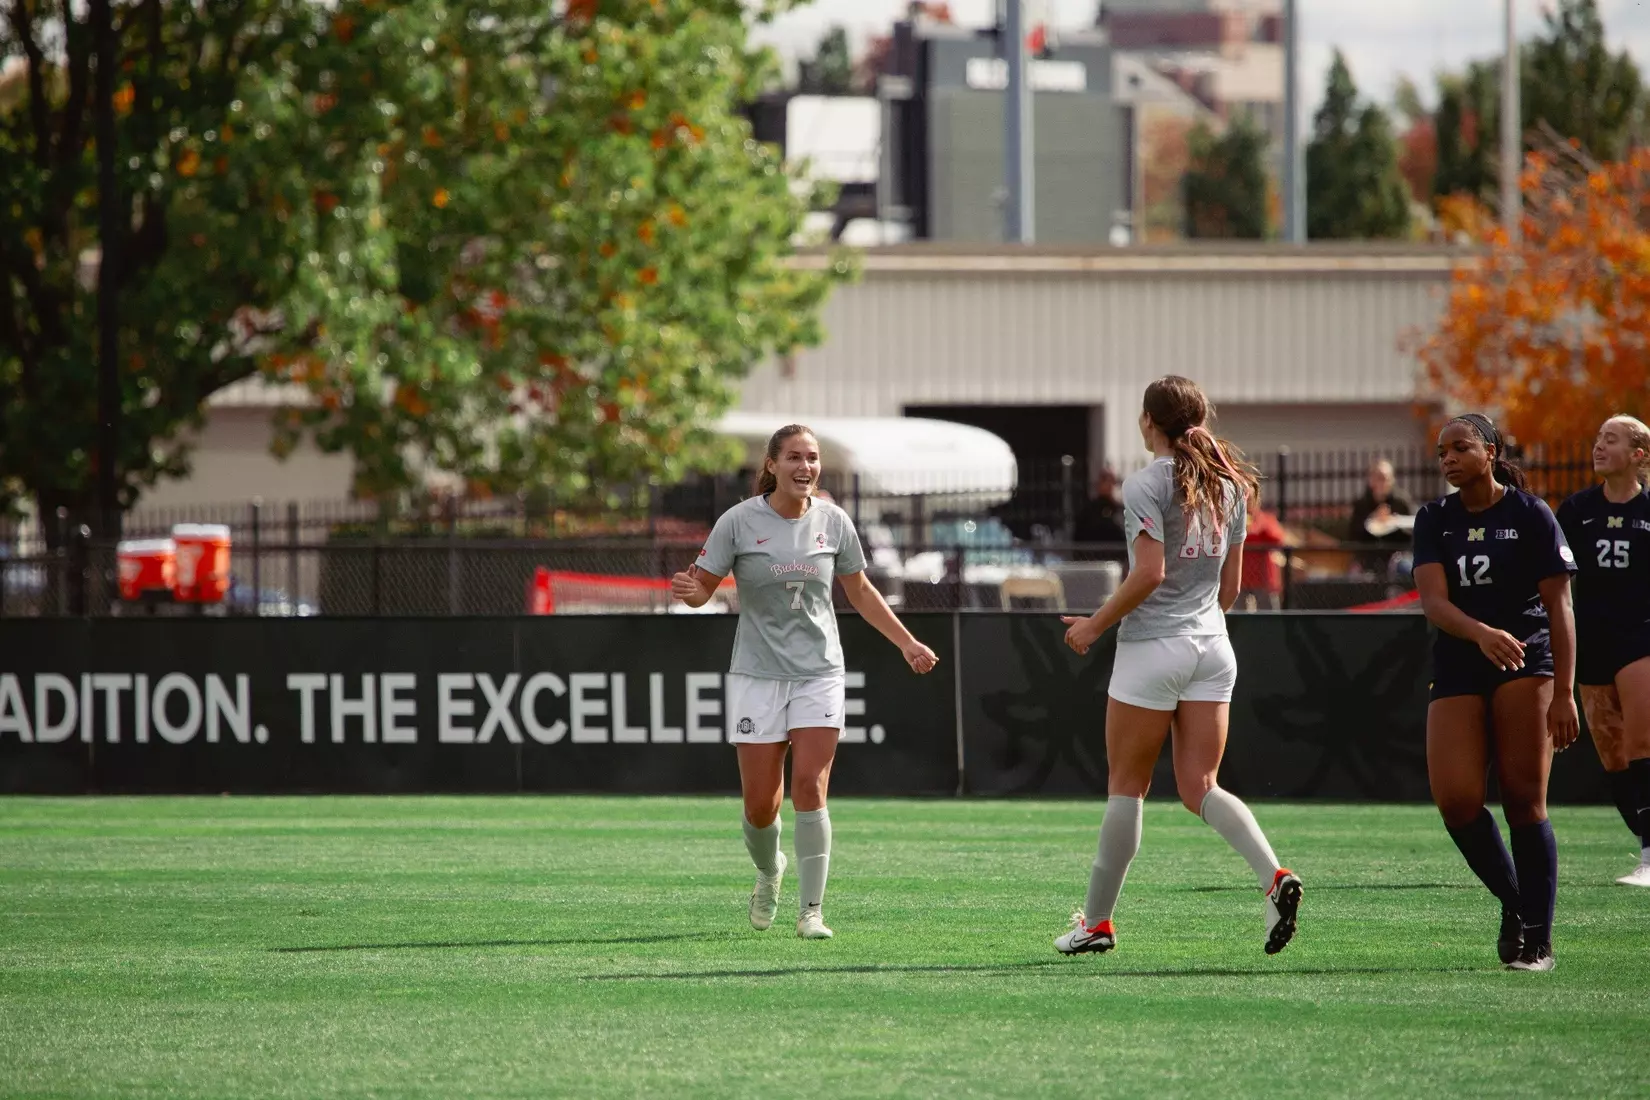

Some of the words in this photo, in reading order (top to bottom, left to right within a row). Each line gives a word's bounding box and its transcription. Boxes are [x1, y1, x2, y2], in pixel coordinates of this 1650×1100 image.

[1467, 527, 1486, 541] M
[770, 558, 820, 578] Buckeyes
[1595, 538, 1630, 569] 25
[1456, 554, 1493, 587] 12
[785, 580, 805, 610] 7
[0, 672, 269, 744] ADITION.
[286, 672, 418, 744] THE
[437, 672, 886, 745] EXCELLEE.
